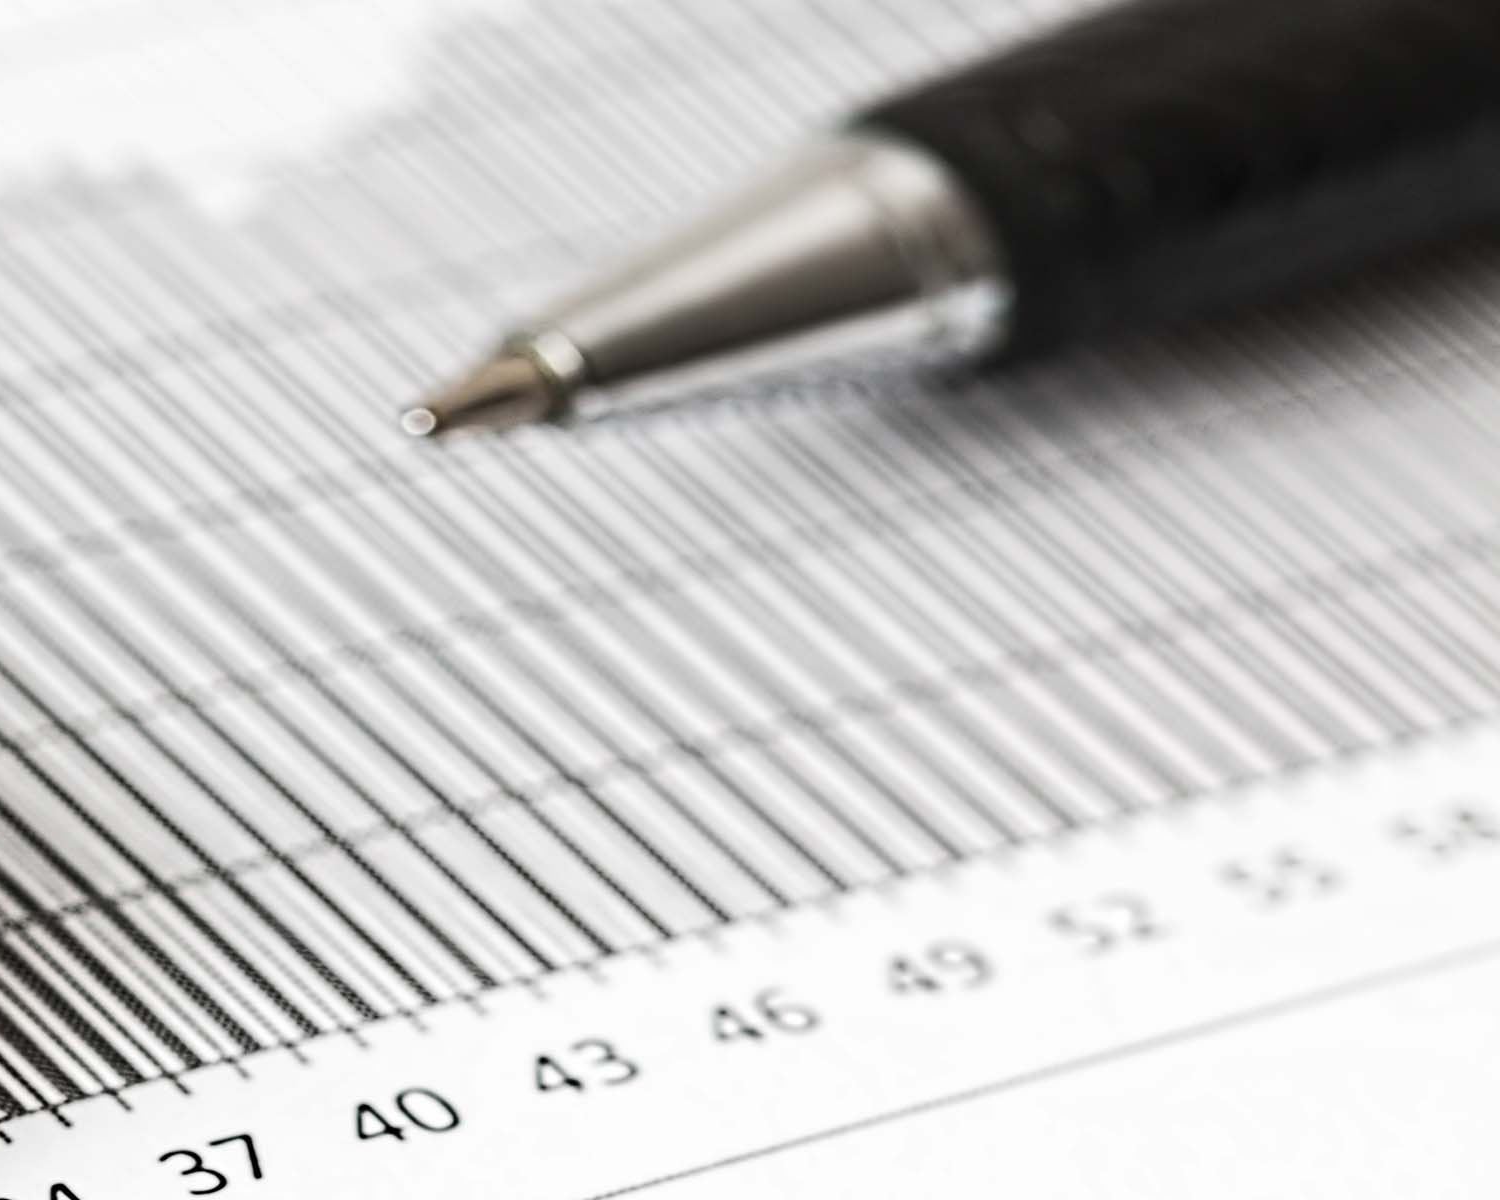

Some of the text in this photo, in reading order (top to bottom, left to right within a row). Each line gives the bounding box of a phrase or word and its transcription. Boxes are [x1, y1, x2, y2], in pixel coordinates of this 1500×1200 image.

[157, 1132, 264, 1197] 37
[354, 1086, 462, 1143] 40
[534, 1037, 640, 1094] 43
[707, 985, 825, 1047] 46
[884, 938, 998, 998] 49
[1042, 892, 1171, 958] 52
